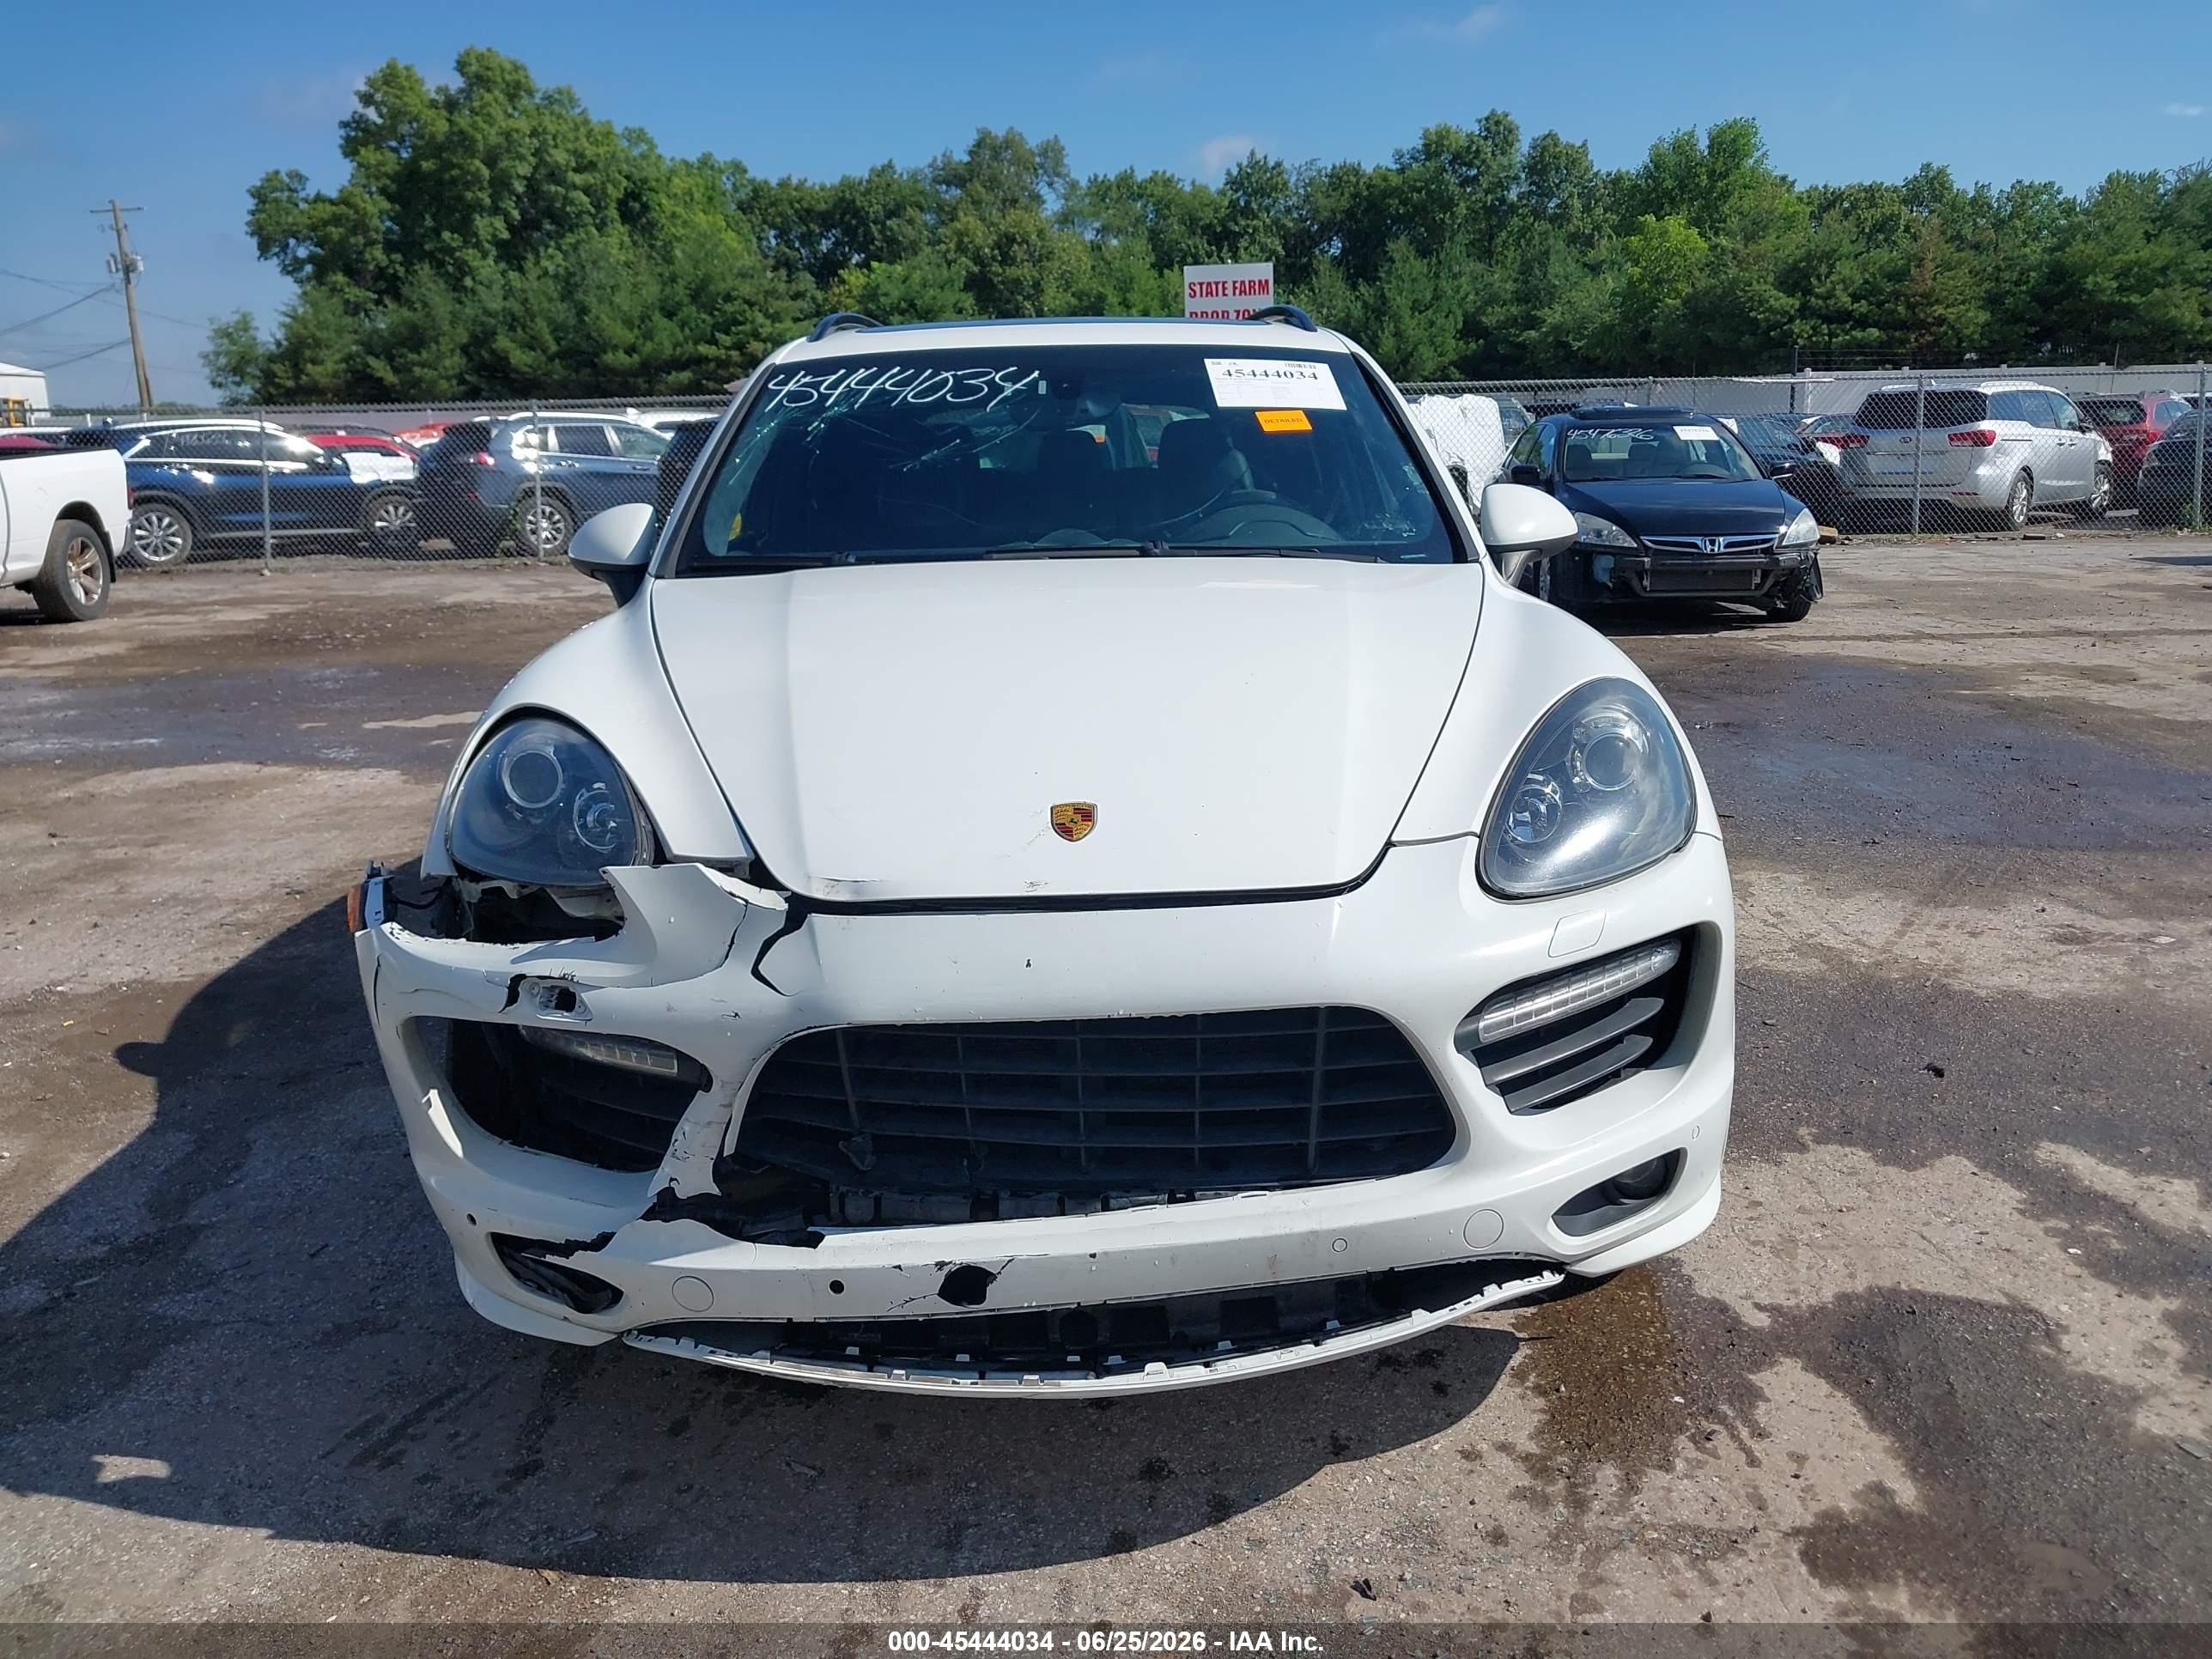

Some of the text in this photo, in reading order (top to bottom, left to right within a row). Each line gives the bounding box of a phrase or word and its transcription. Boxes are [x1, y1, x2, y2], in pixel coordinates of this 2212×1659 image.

[1188, 279, 1269, 299] STATE FARM
[1222, 369, 1318, 380] 45444034
[765, 367, 1039, 412] 45444034
